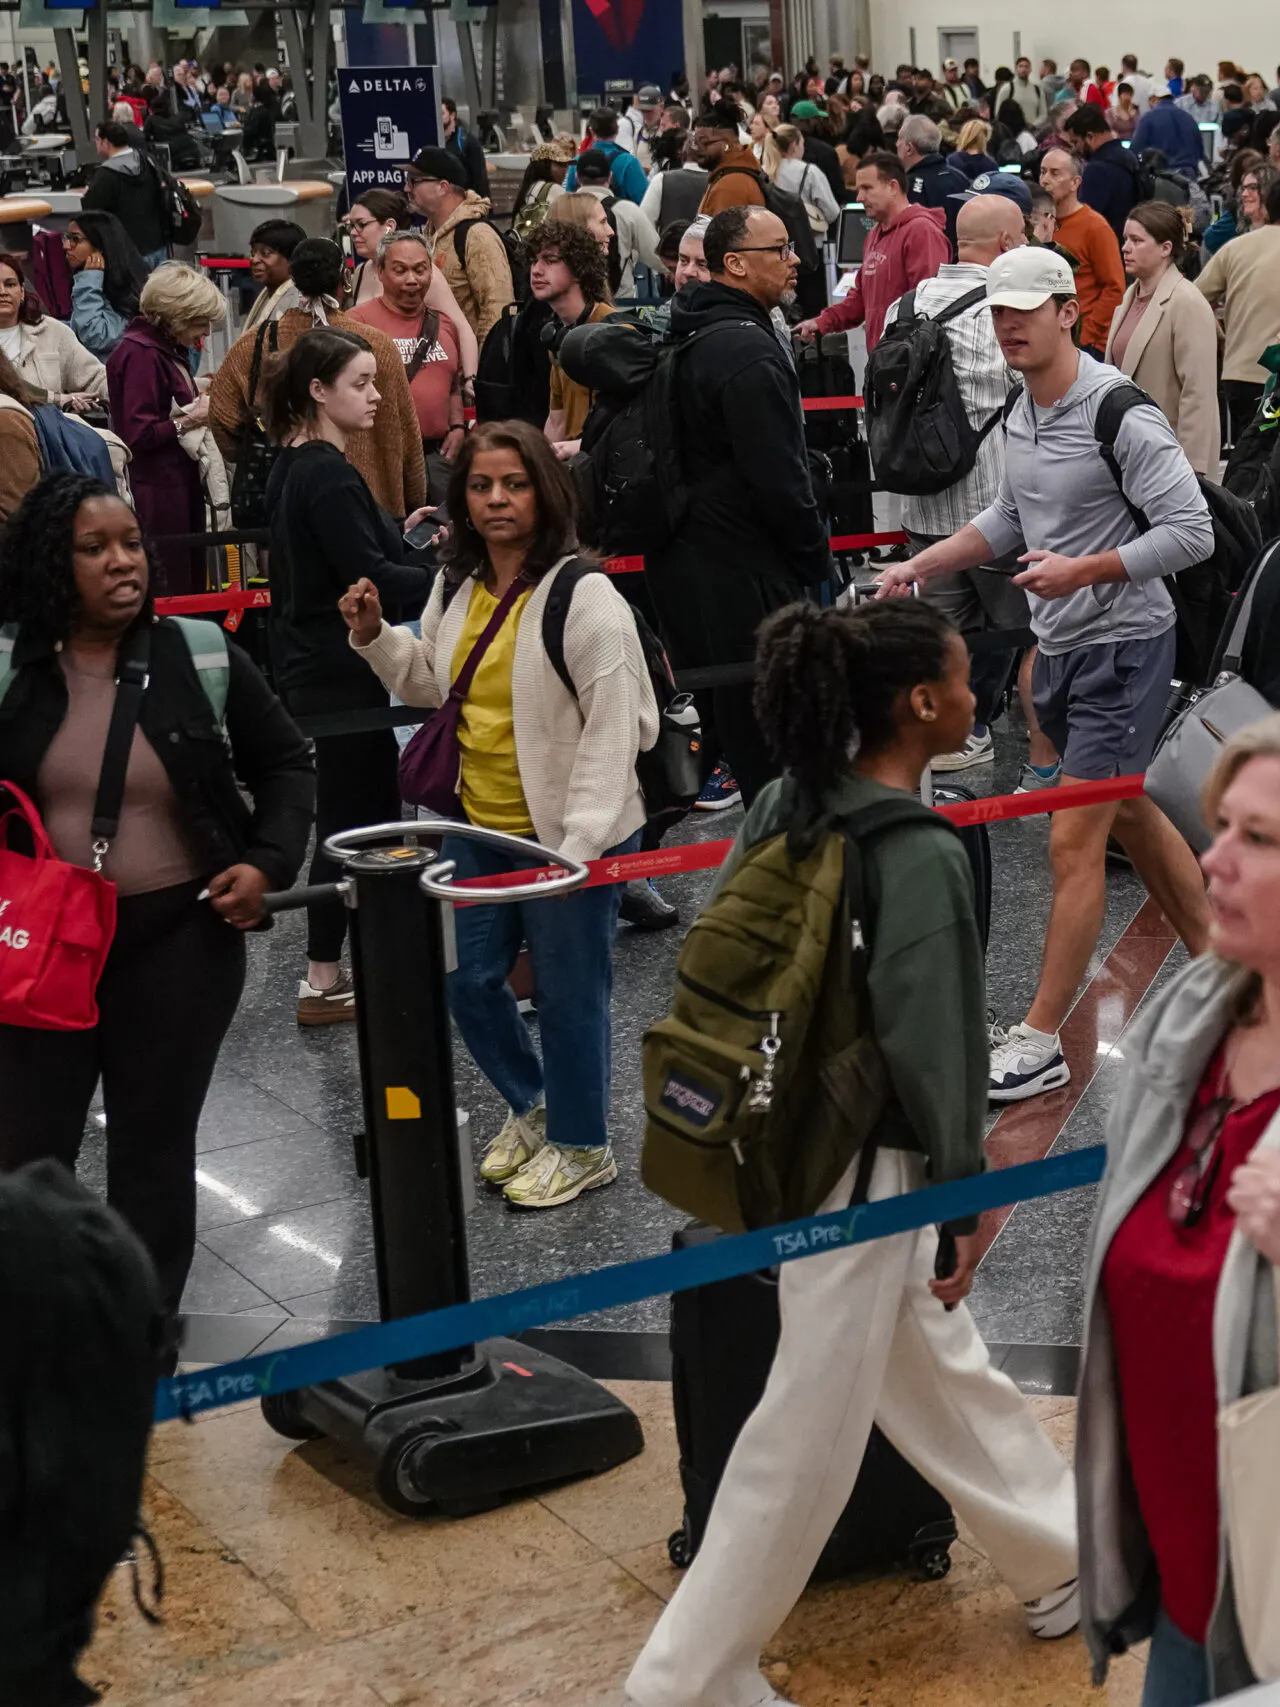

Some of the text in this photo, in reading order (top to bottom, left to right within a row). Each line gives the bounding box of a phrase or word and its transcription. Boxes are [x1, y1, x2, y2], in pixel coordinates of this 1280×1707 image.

[363, 79, 412, 92] DELTA
[352, 170, 376, 183] APP
[377, 170, 402, 183] BAG
[0, 926, 30, 950] AG
[772, 1224, 842, 1256] TSA Pre
[215, 1372, 257, 1397] Pre
